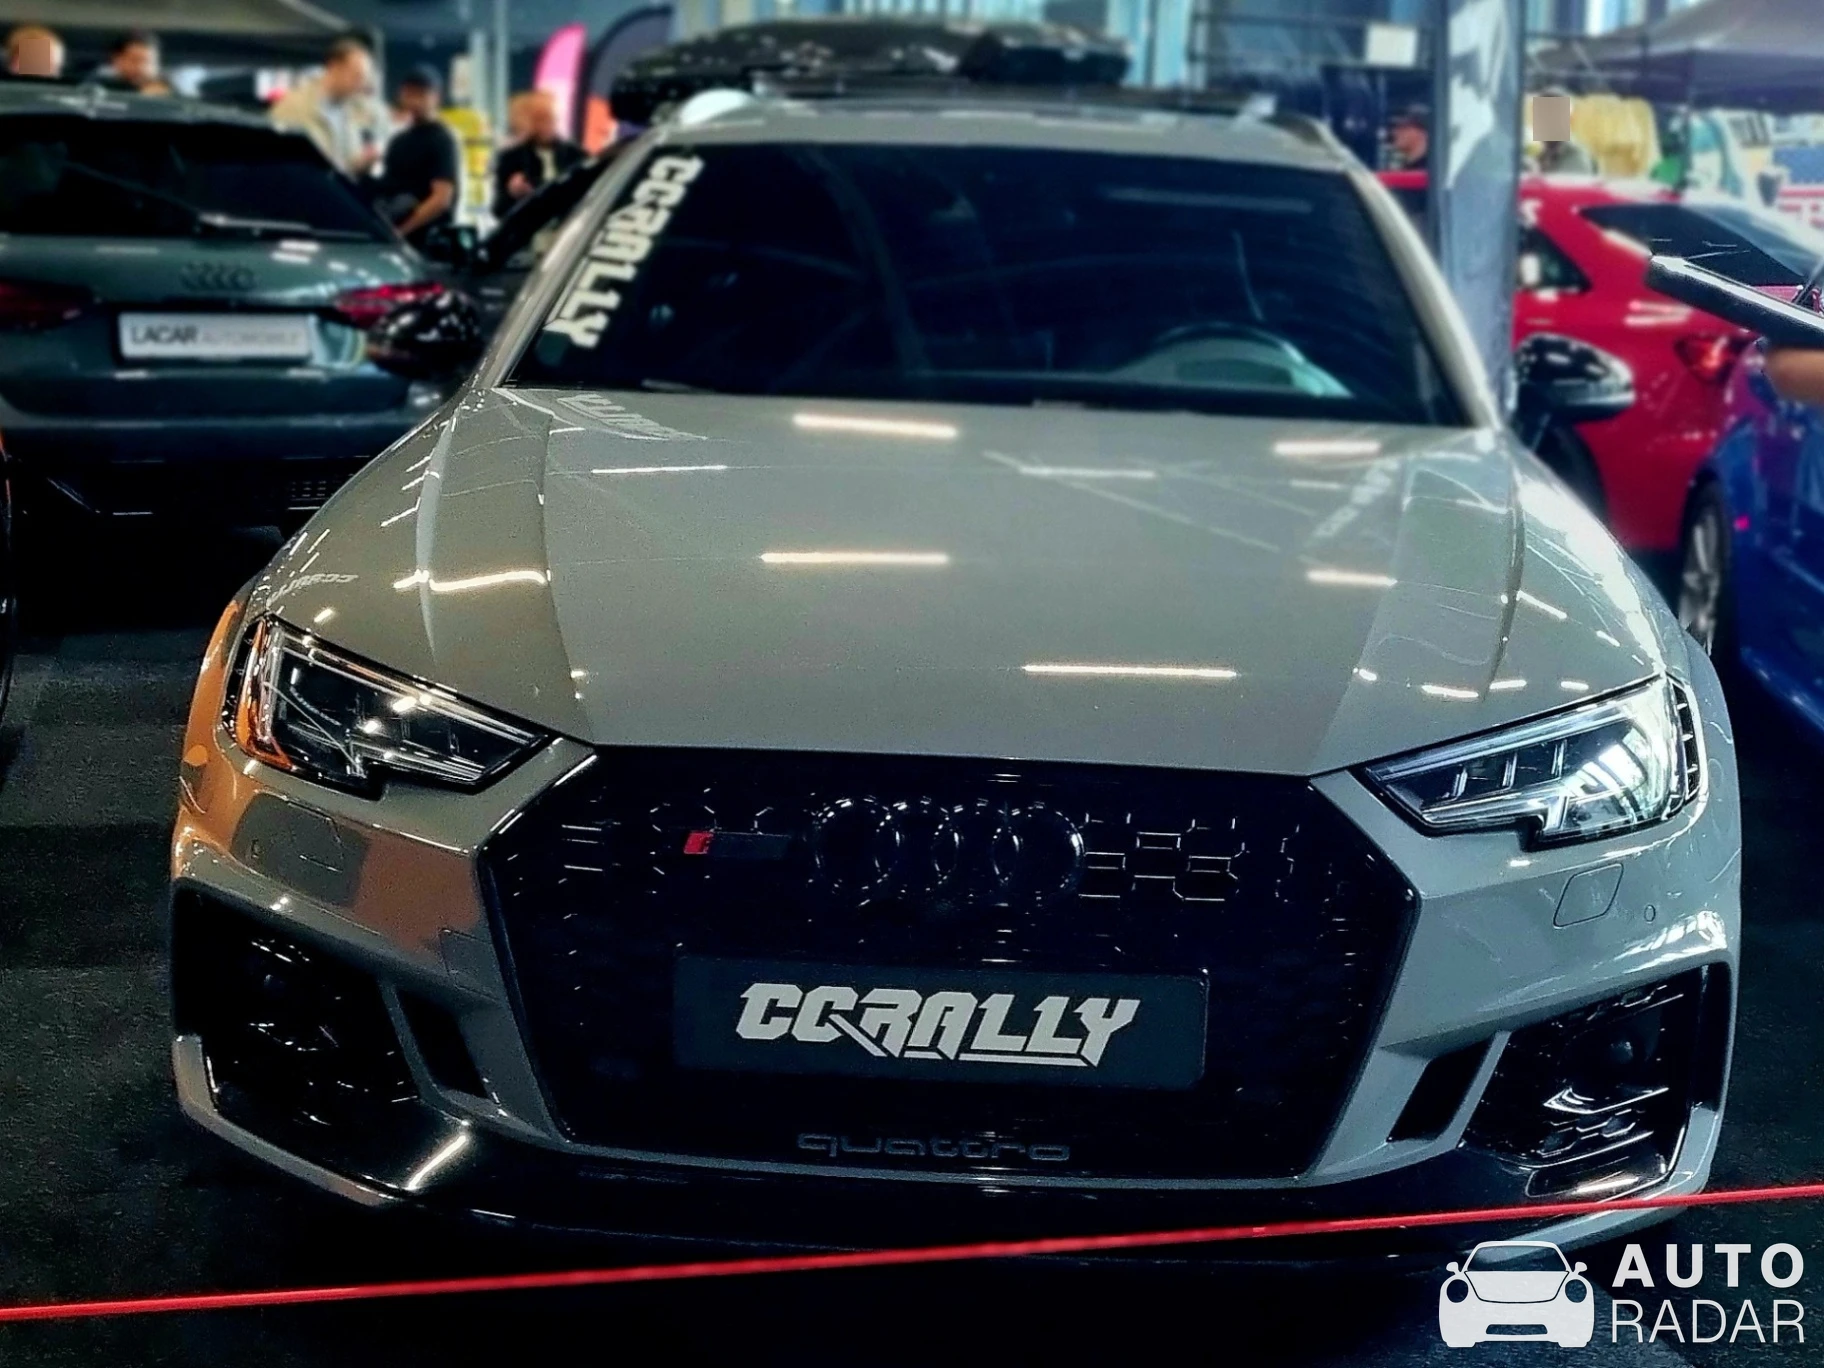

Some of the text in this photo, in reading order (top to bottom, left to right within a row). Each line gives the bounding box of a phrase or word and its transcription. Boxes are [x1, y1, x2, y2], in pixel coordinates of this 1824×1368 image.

[543, 156, 705, 348] CCRALLY
[131, 325, 198, 345] LACAR
[736, 982, 1141, 1067] CCRALLY
[797, 1132, 1069, 1161] quattro
